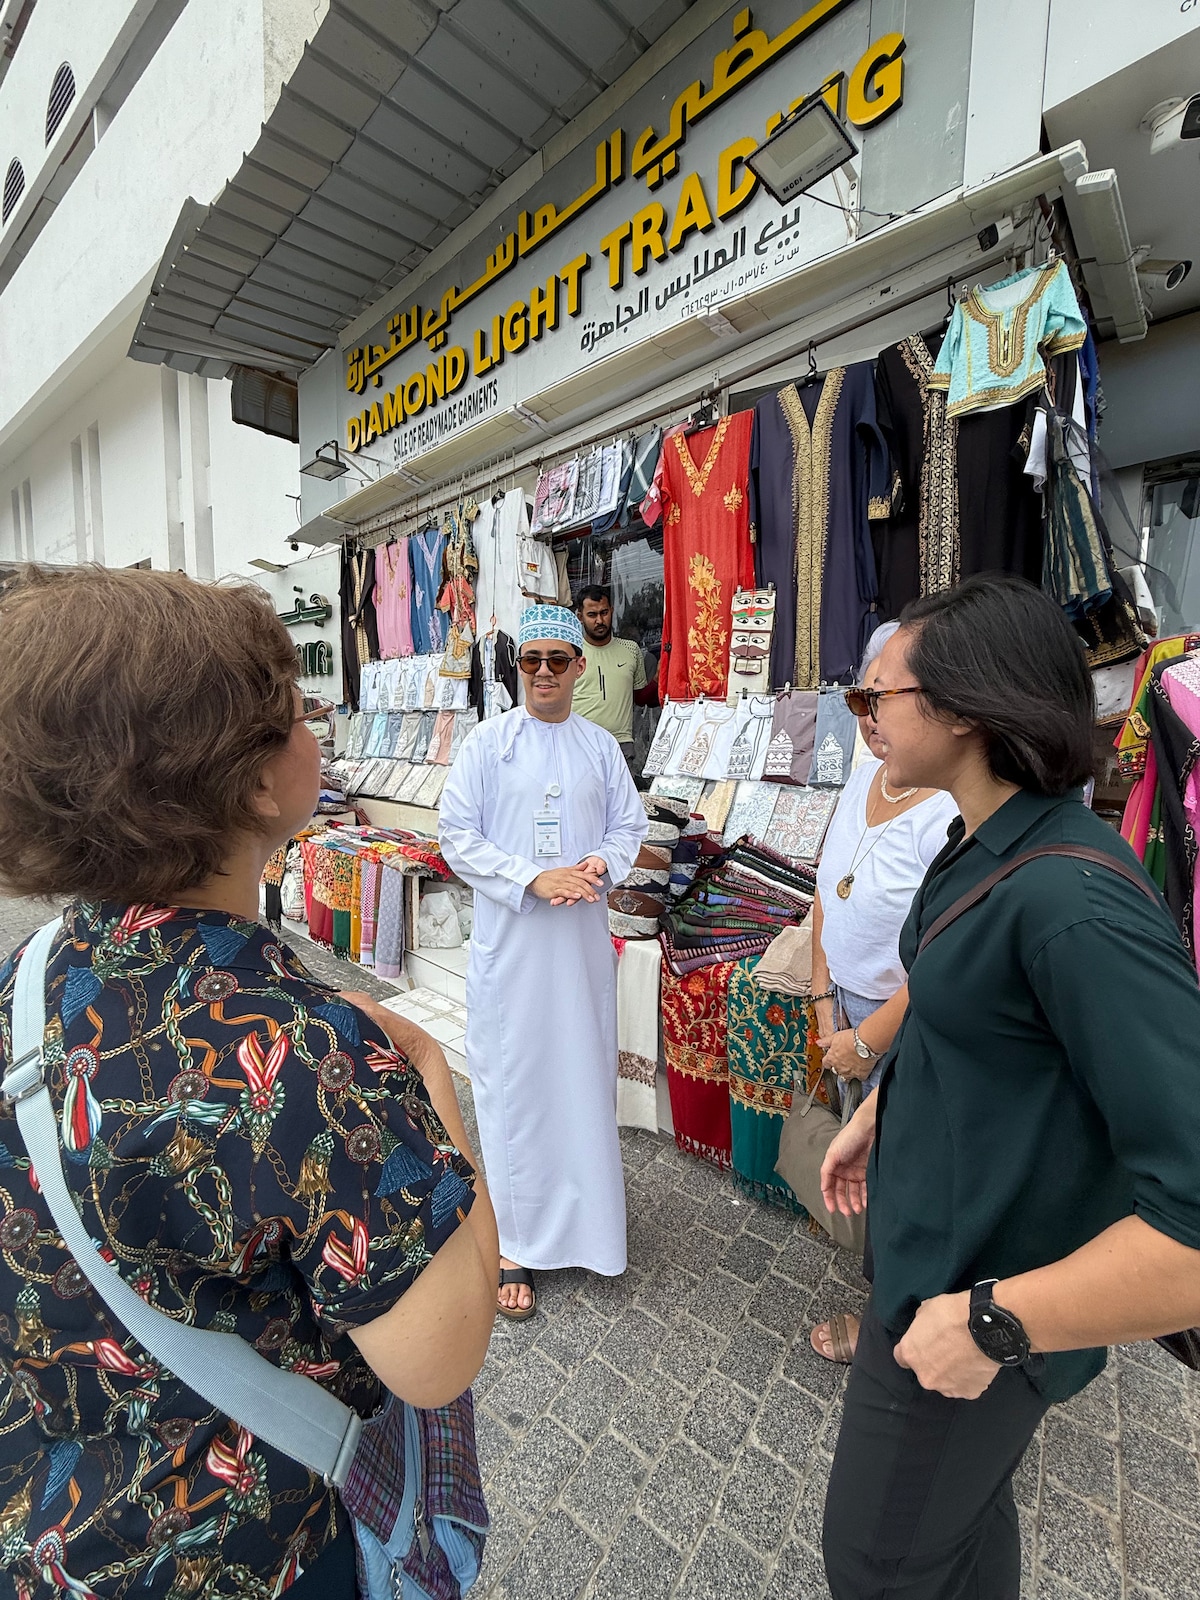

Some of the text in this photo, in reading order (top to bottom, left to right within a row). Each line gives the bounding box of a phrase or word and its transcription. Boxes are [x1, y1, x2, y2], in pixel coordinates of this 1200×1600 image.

[346, 32, 907, 453] DIAMOND LIGHT TRADG
[421, 127, 627, 352] الماسي
[580, 206, 801, 353] بيع الملابس الجاهزة
[346, 303, 421, 395] للتجارة
[393, 432, 408, 461] SALE
[408, 427, 417, 453] OF
[417, 403, 457, 449] READYMADE
[458, 378, 498, 426] GARMENTS
